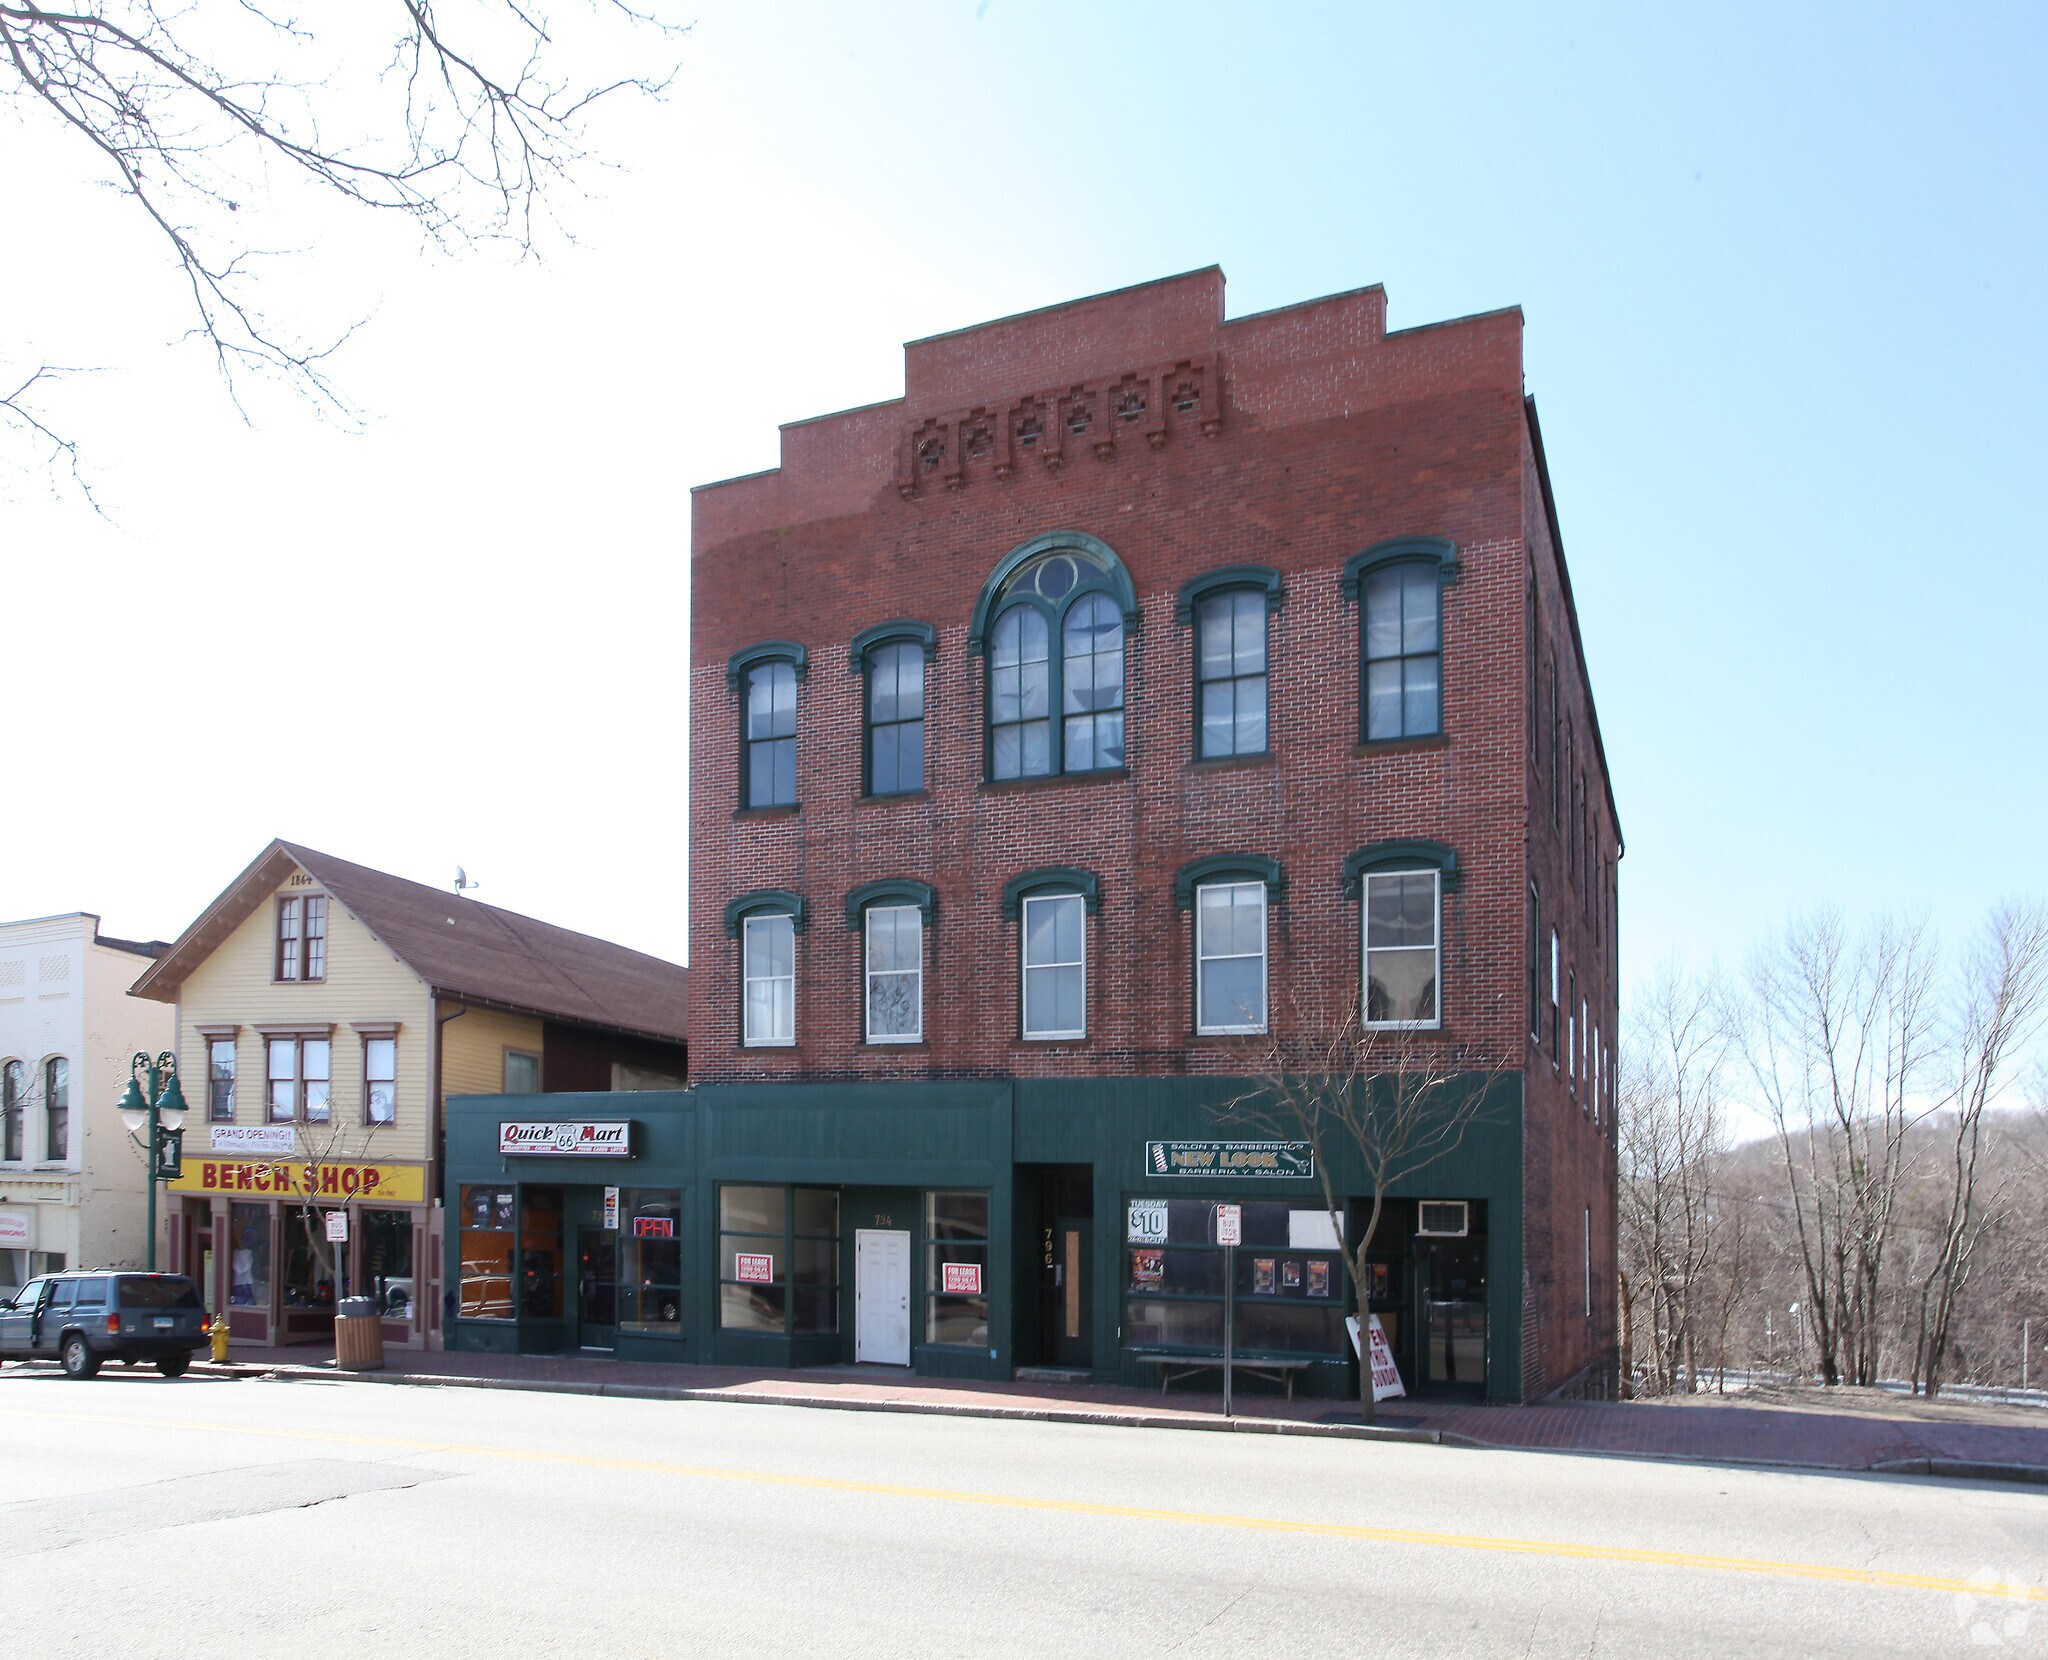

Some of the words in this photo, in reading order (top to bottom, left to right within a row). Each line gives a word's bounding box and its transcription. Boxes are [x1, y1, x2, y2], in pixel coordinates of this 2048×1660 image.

[214, 1128, 244, 1139] GRAND
[246, 1129, 291, 1140] OPENING!!
[504, 1125, 553, 1144] Quick
[580, 1125, 623, 1141] Mart
[558, 1135, 573, 1148] 66
[1225, 1143, 1305, 1151] BARBERSHOP
[1170, 1151, 1217, 1167] NEW
[1219, 1151, 1280, 1169] LOOK
[202, 1162, 290, 1191] BENCH
[303, 1165, 380, 1195] SHOP
[1178, 1168, 1238, 1176] BARBERIA
[1242, 1168, 1250, 1176] Y
[1254, 1168, 1296, 1176] SALON
[1130, 1200, 1167, 1208] TUESDAY
[635, 1218, 671, 1237] OPEN
[1131, 1210, 1164, 1235] $10
[1044, 1228, 1053, 1264] 796
[740, 1257, 751, 1265] FOR
[751, 1258, 768, 1266] LEASE
[948, 1267, 959, 1275] FOR
[959, 1267, 976, 1276] LEASE
